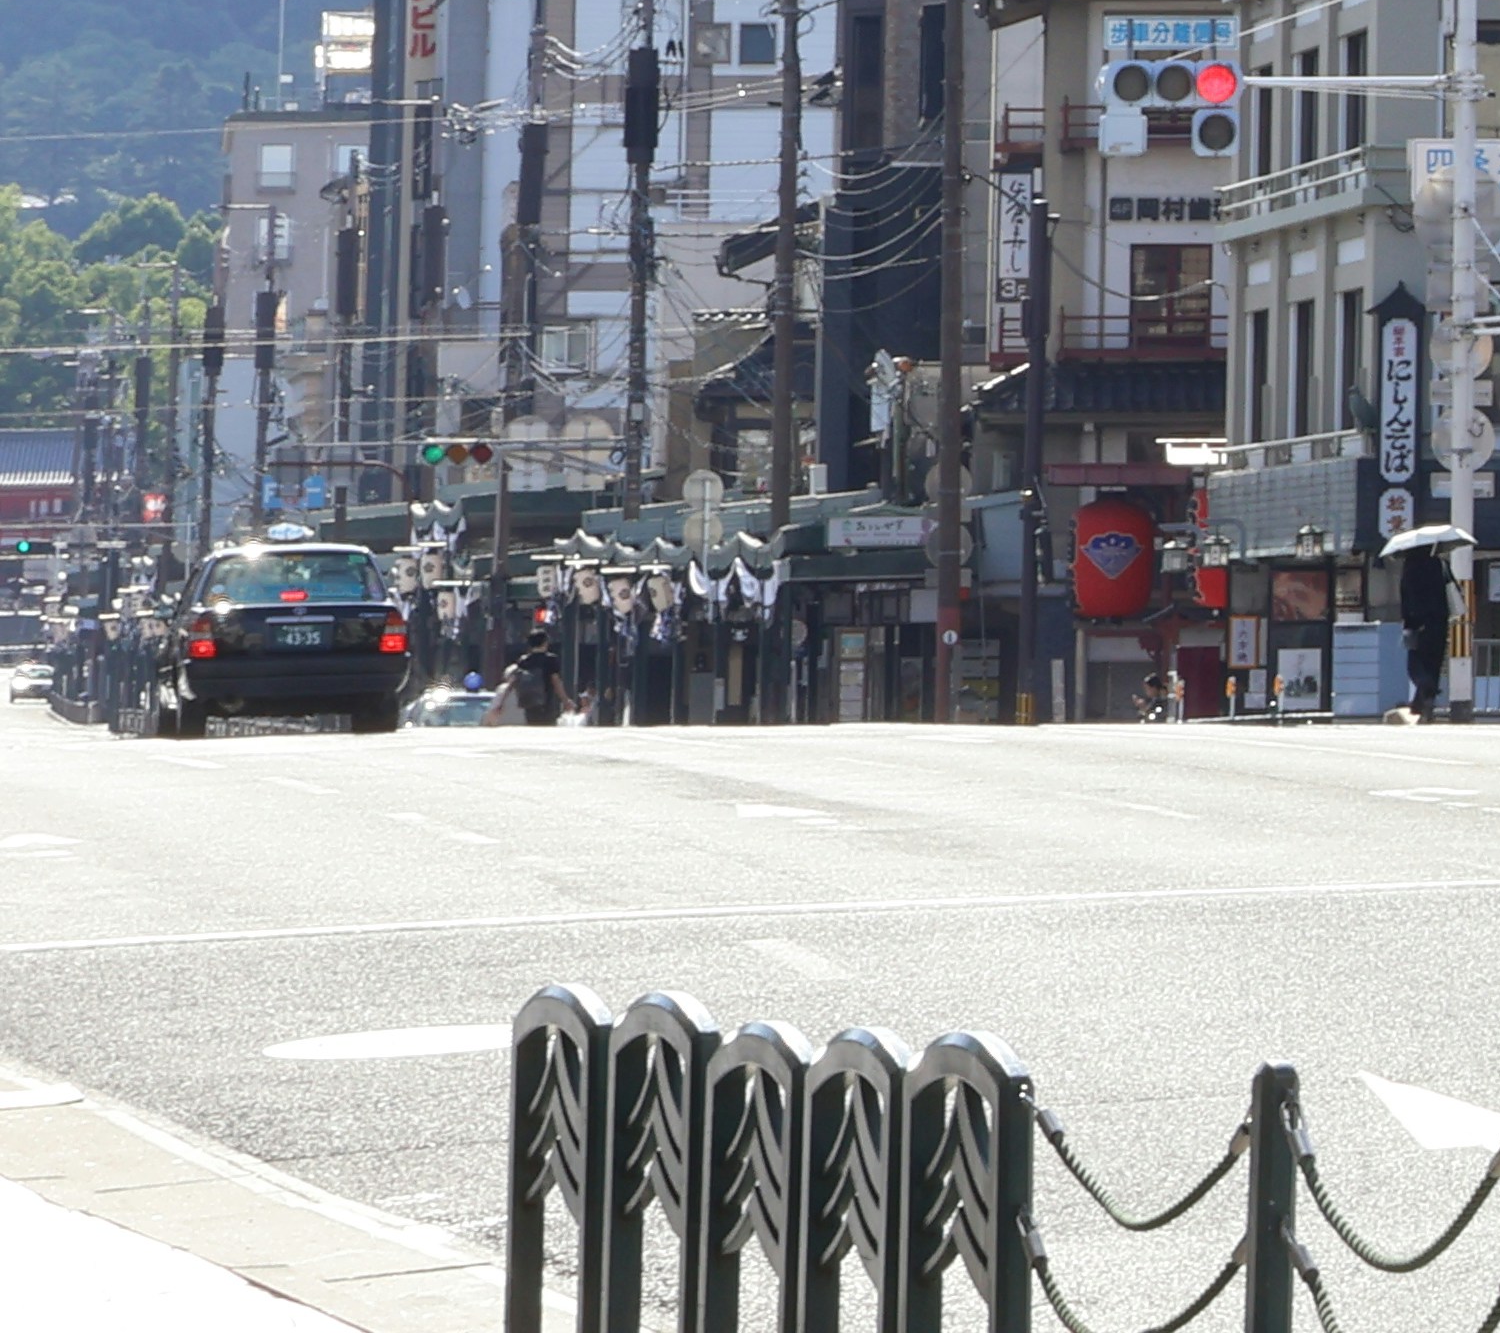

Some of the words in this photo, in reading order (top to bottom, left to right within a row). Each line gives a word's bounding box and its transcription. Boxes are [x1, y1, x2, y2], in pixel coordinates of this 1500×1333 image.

[1111, 22, 1232, 44] 歩車分離信号
[1384, 359, 1412, 473] にしんそば
